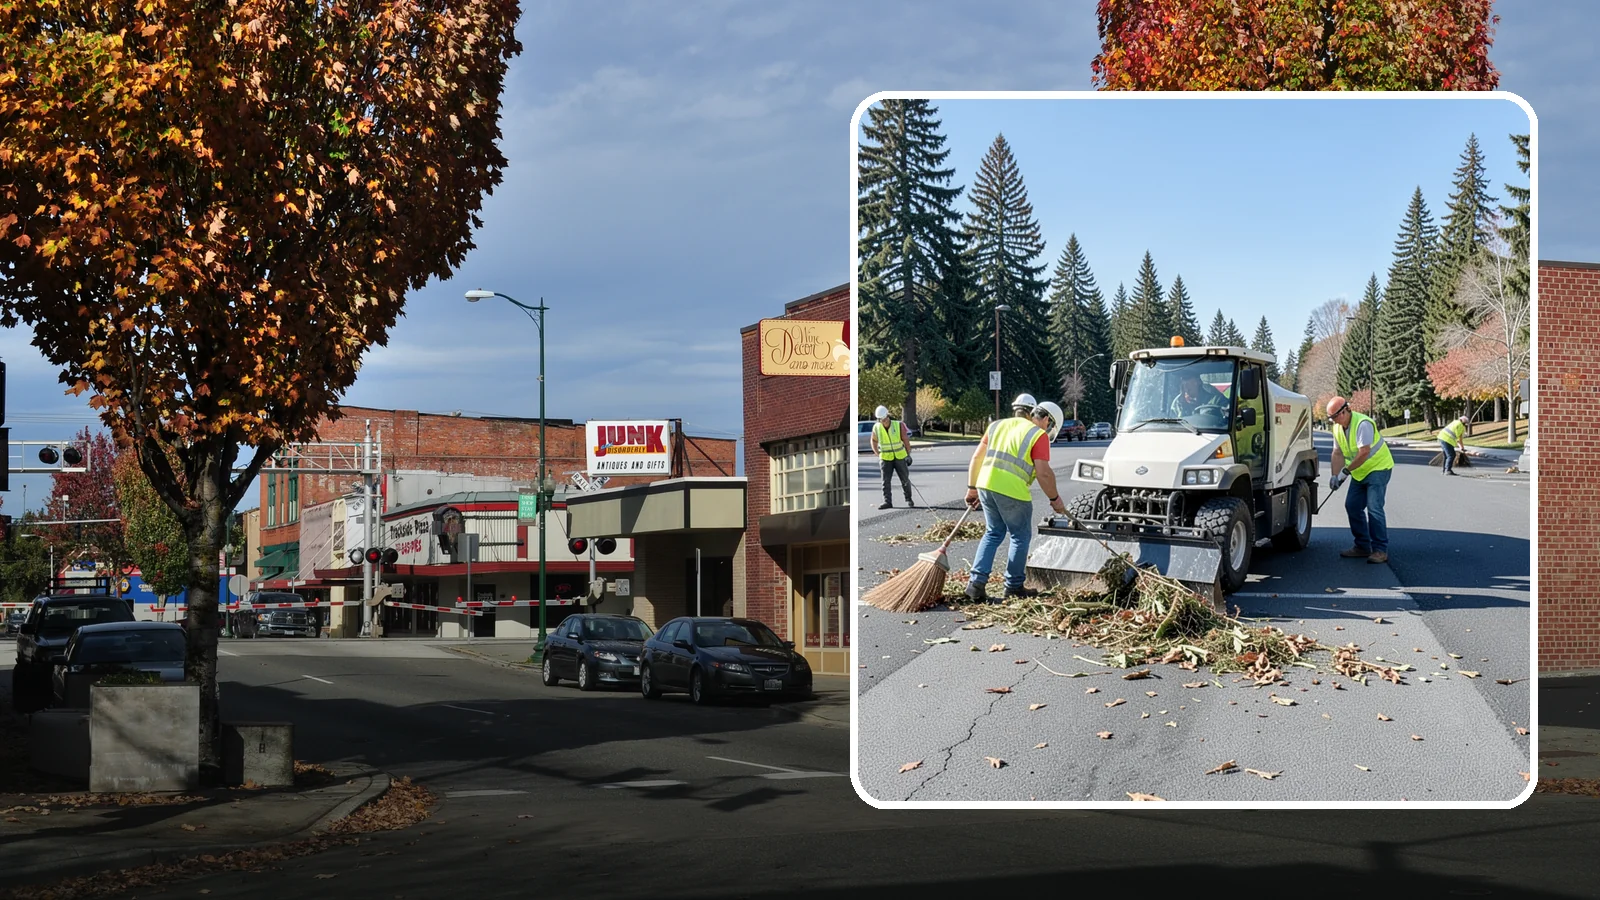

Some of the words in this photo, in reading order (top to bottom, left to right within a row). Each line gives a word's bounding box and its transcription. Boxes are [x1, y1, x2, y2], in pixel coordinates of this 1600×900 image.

[595, 425, 664, 457] JUNK
[607, 446, 646, 455] DISORDERLY
[597, 461, 628, 470] ANTIQUES
[631, 461, 644, 470] AND
[647, 461, 665, 469] GIFTS
